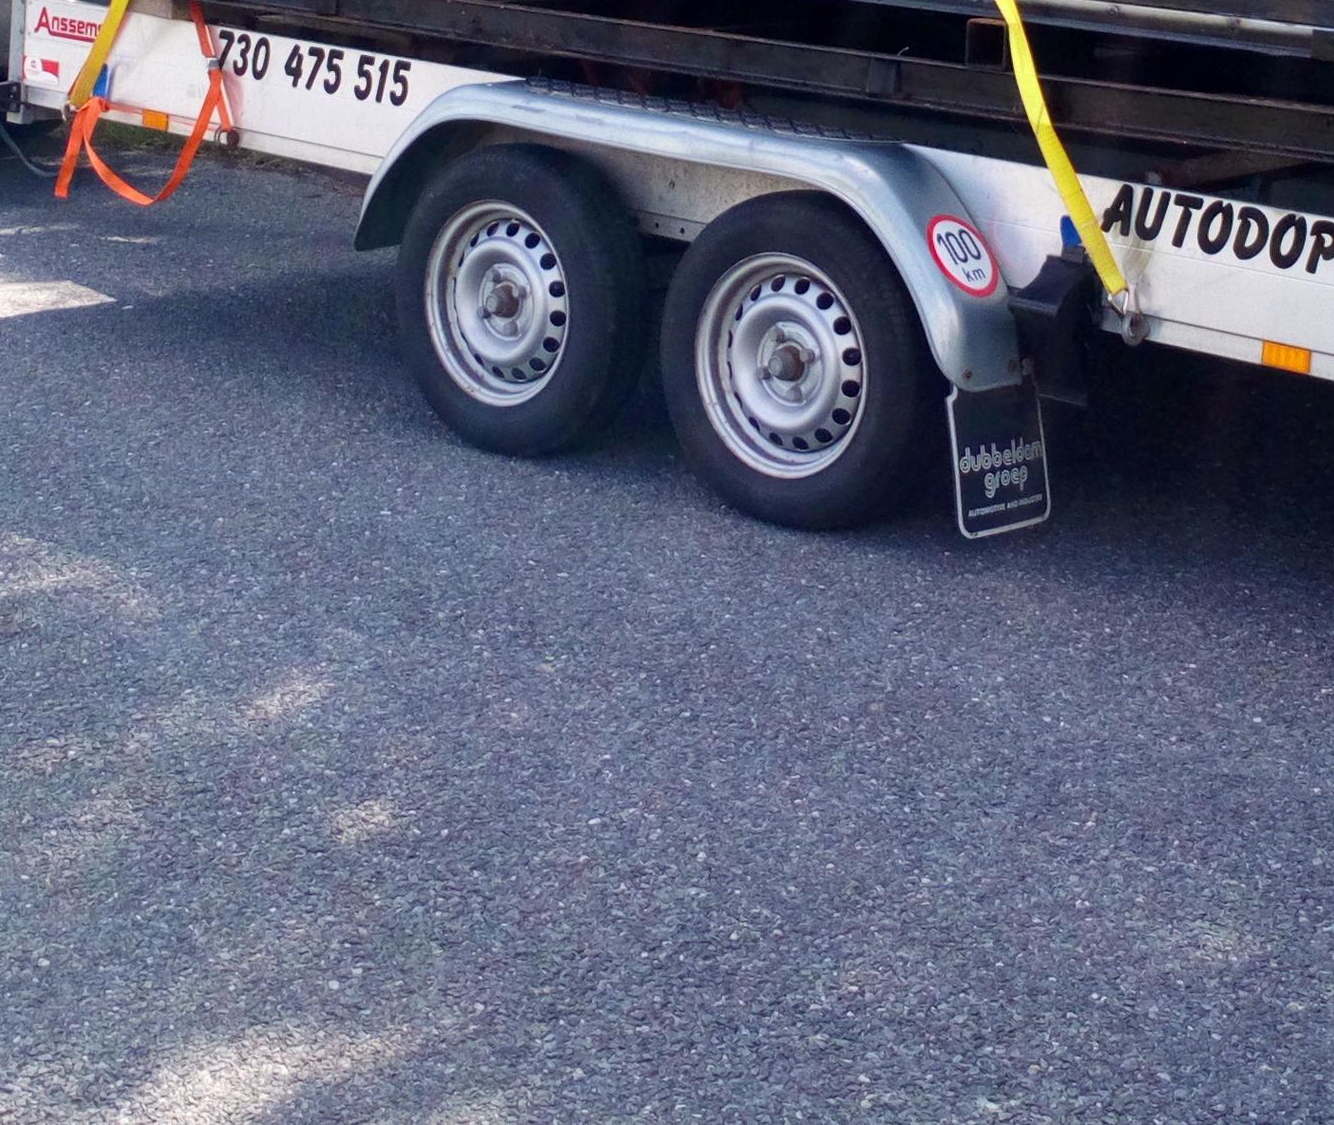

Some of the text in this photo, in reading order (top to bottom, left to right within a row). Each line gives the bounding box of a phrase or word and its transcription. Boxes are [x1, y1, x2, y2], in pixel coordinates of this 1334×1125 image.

[218, 30, 412, 106] 730 475 515
[936, 228, 982, 266] 100
[962, 266, 986, 282] km
[959, 437, 1043, 473] dubbeldam
[984, 465, 1028, 498] groep
